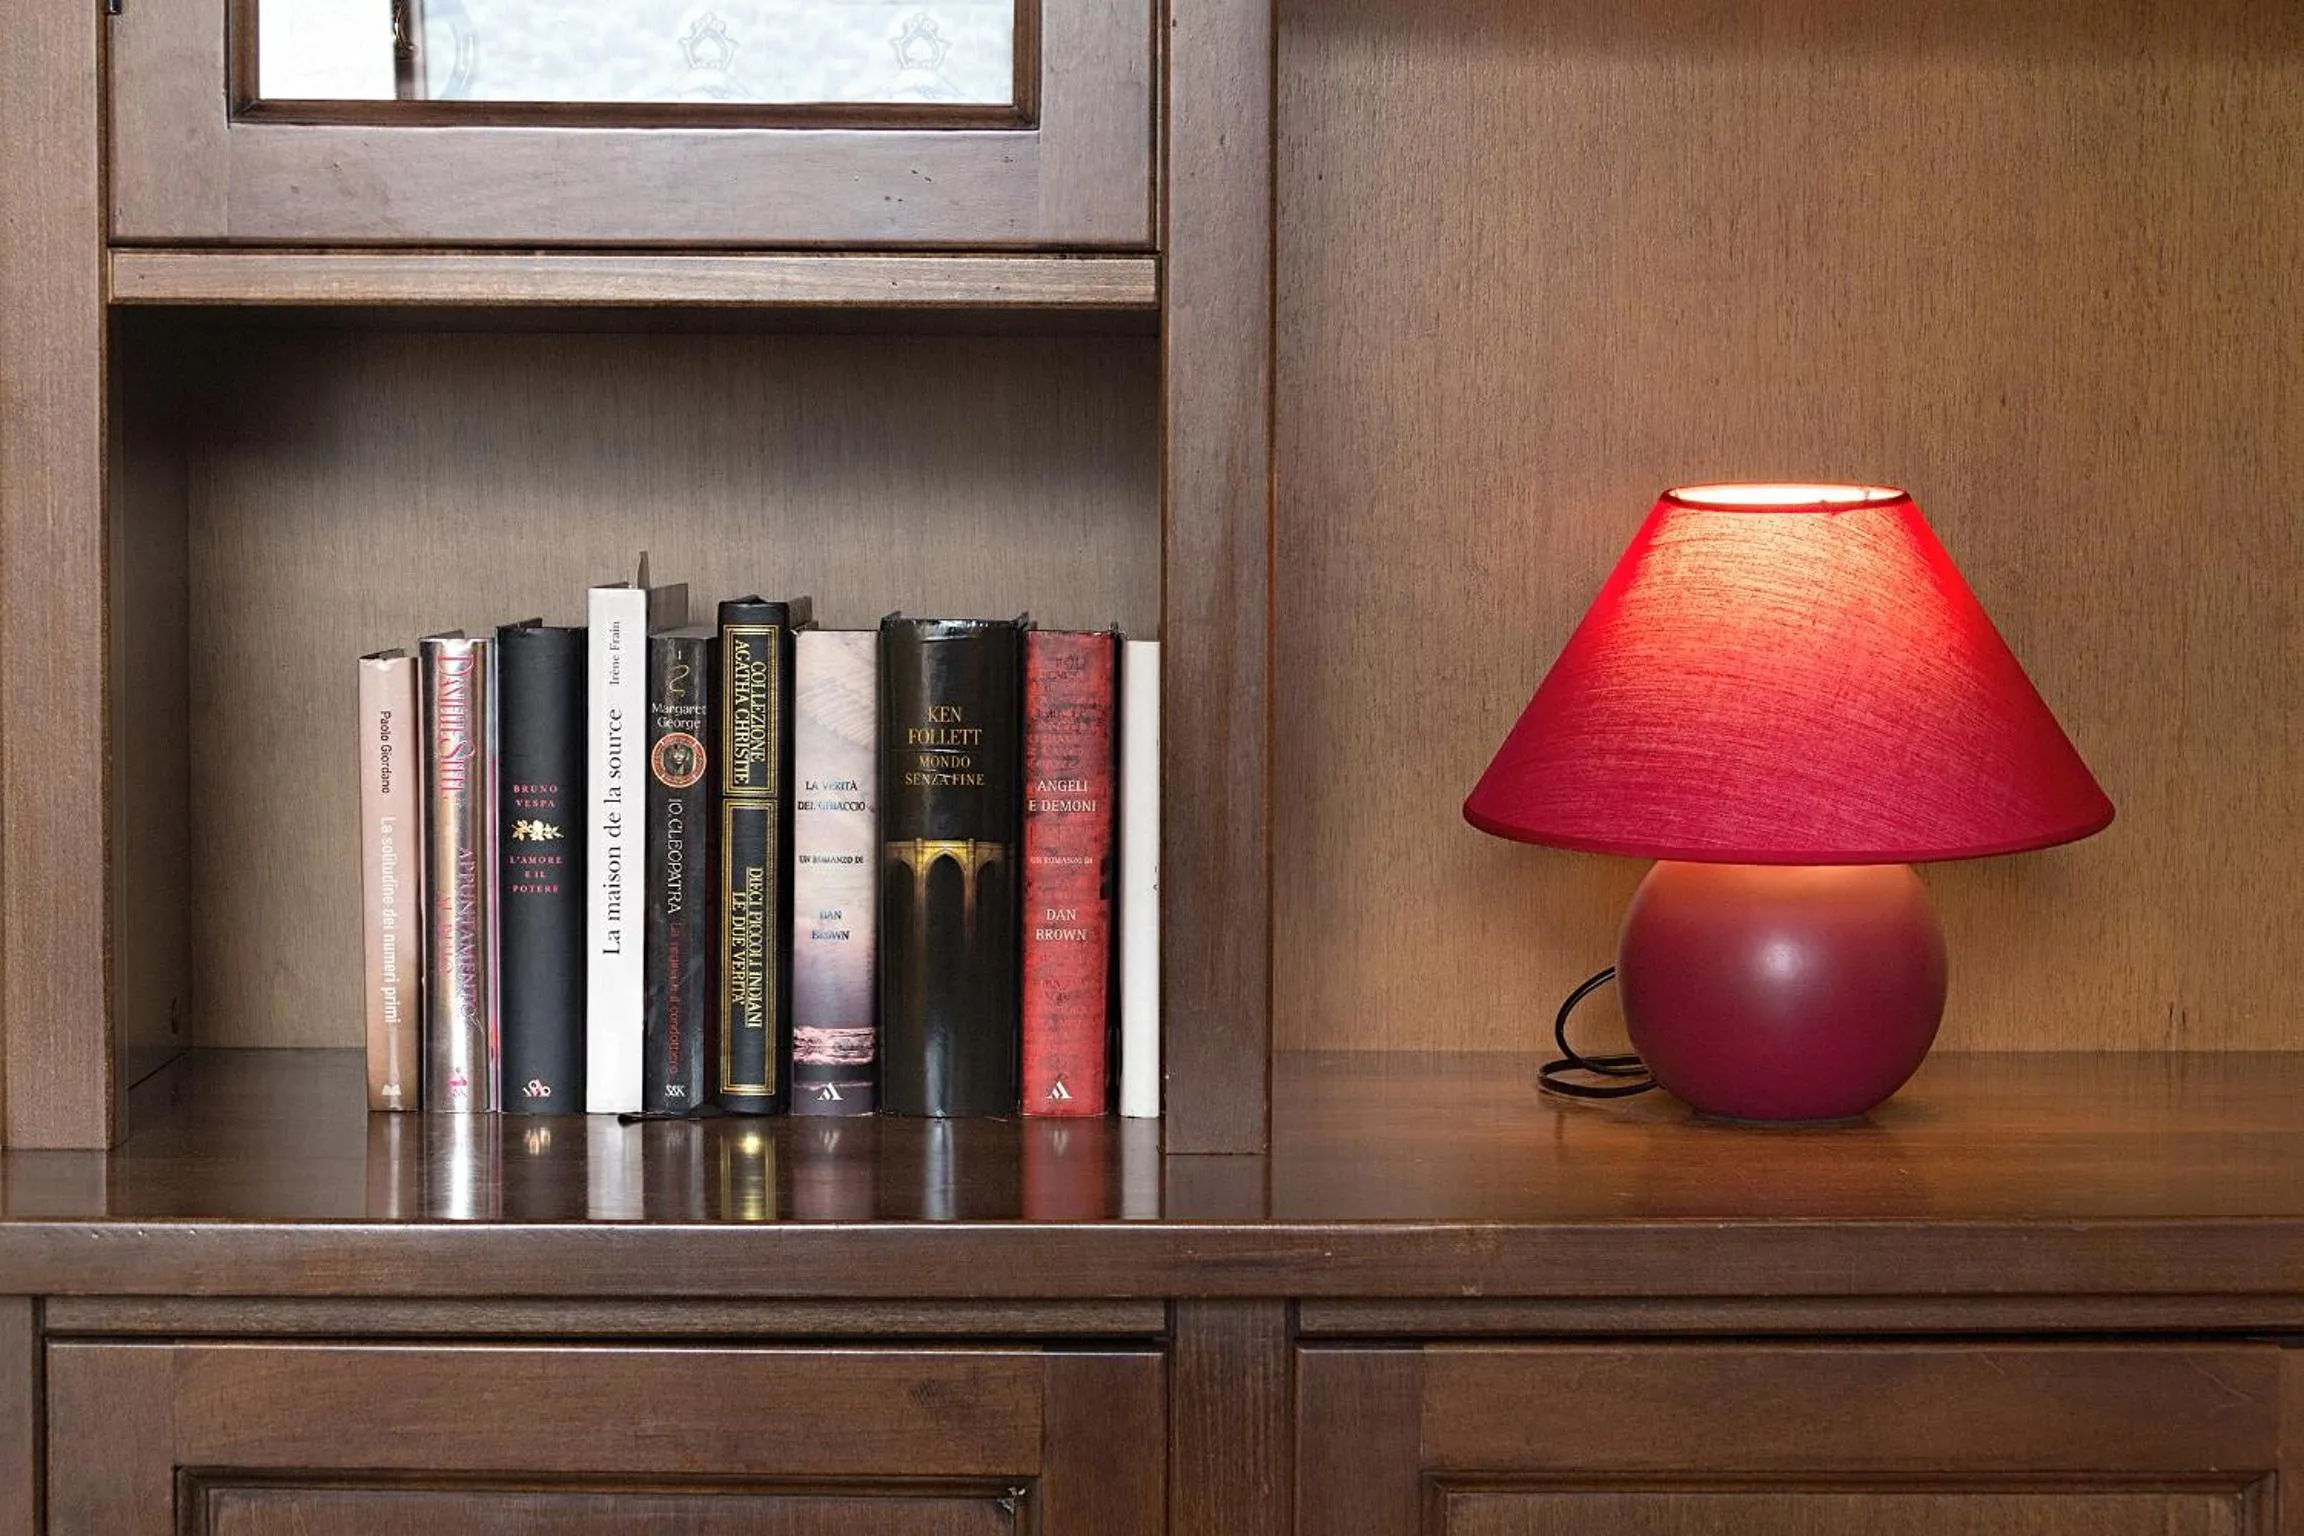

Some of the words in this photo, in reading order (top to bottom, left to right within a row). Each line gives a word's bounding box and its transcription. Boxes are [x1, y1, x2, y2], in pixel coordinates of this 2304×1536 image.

[609, 620, 620, 651] Frain
[609, 655, 620, 685] Irène
[734, 639, 750, 705] AGATHA
[651, 702, 707, 717] Margaret
[750, 660, 767, 763] COLLEZIONE
[927, 705, 962, 723] KEN
[380, 710, 391, 742] Paolo
[656, 716, 702, 730] George
[607, 708, 623, 780] source
[907, 727, 983, 745] FOLLETT
[733, 708, 750, 785] CHRISTIE
[380, 744, 393, 794] Giordano
[919, 755, 971, 769] MONDO
[805, 780, 818, 791] LA
[904, 772, 950, 786] SENZA
[952, 773, 985, 786] FINE
[1037, 779, 1089, 792] ANGELI
[512, 784, 558, 794] BRUNO
[603, 787, 622, 804] la
[514, 799, 556, 809] VESPA
[797, 801, 815, 811] DEL
[1028, 799, 1038, 812] E
[1041, 799, 1096, 812] DEMONI
[381, 817, 396, 833] La
[603, 812, 622, 838] de
[509, 855, 564, 865] L'AMORE
[798, 855, 810, 864] UN
[812, 855, 853, 864] ROMANZO
[854, 855, 864, 864] DI
[381, 838, 398, 904] solitudine
[534, 870, 546, 880] IL
[511, 884, 559, 894] POTERE
[602, 846, 622, 919] maison
[748, 866, 764, 906] DIECI
[732, 891, 746, 911] LE
[383, 908, 398, 929] dei
[819, 910, 843, 920] DAN
[1045, 908, 1076, 921] DAN
[732, 916, 746, 947] DUE
[748, 910, 764, 967] PICCOLI
[811, 930, 850, 940] BROWN
[1035, 928, 1086, 941] BROWN
[602, 929, 621, 955] La
[383, 934, 400, 982] numeri
[380, 986, 401, 1023] primi
[747, 971, 763, 1029] INDIANI
